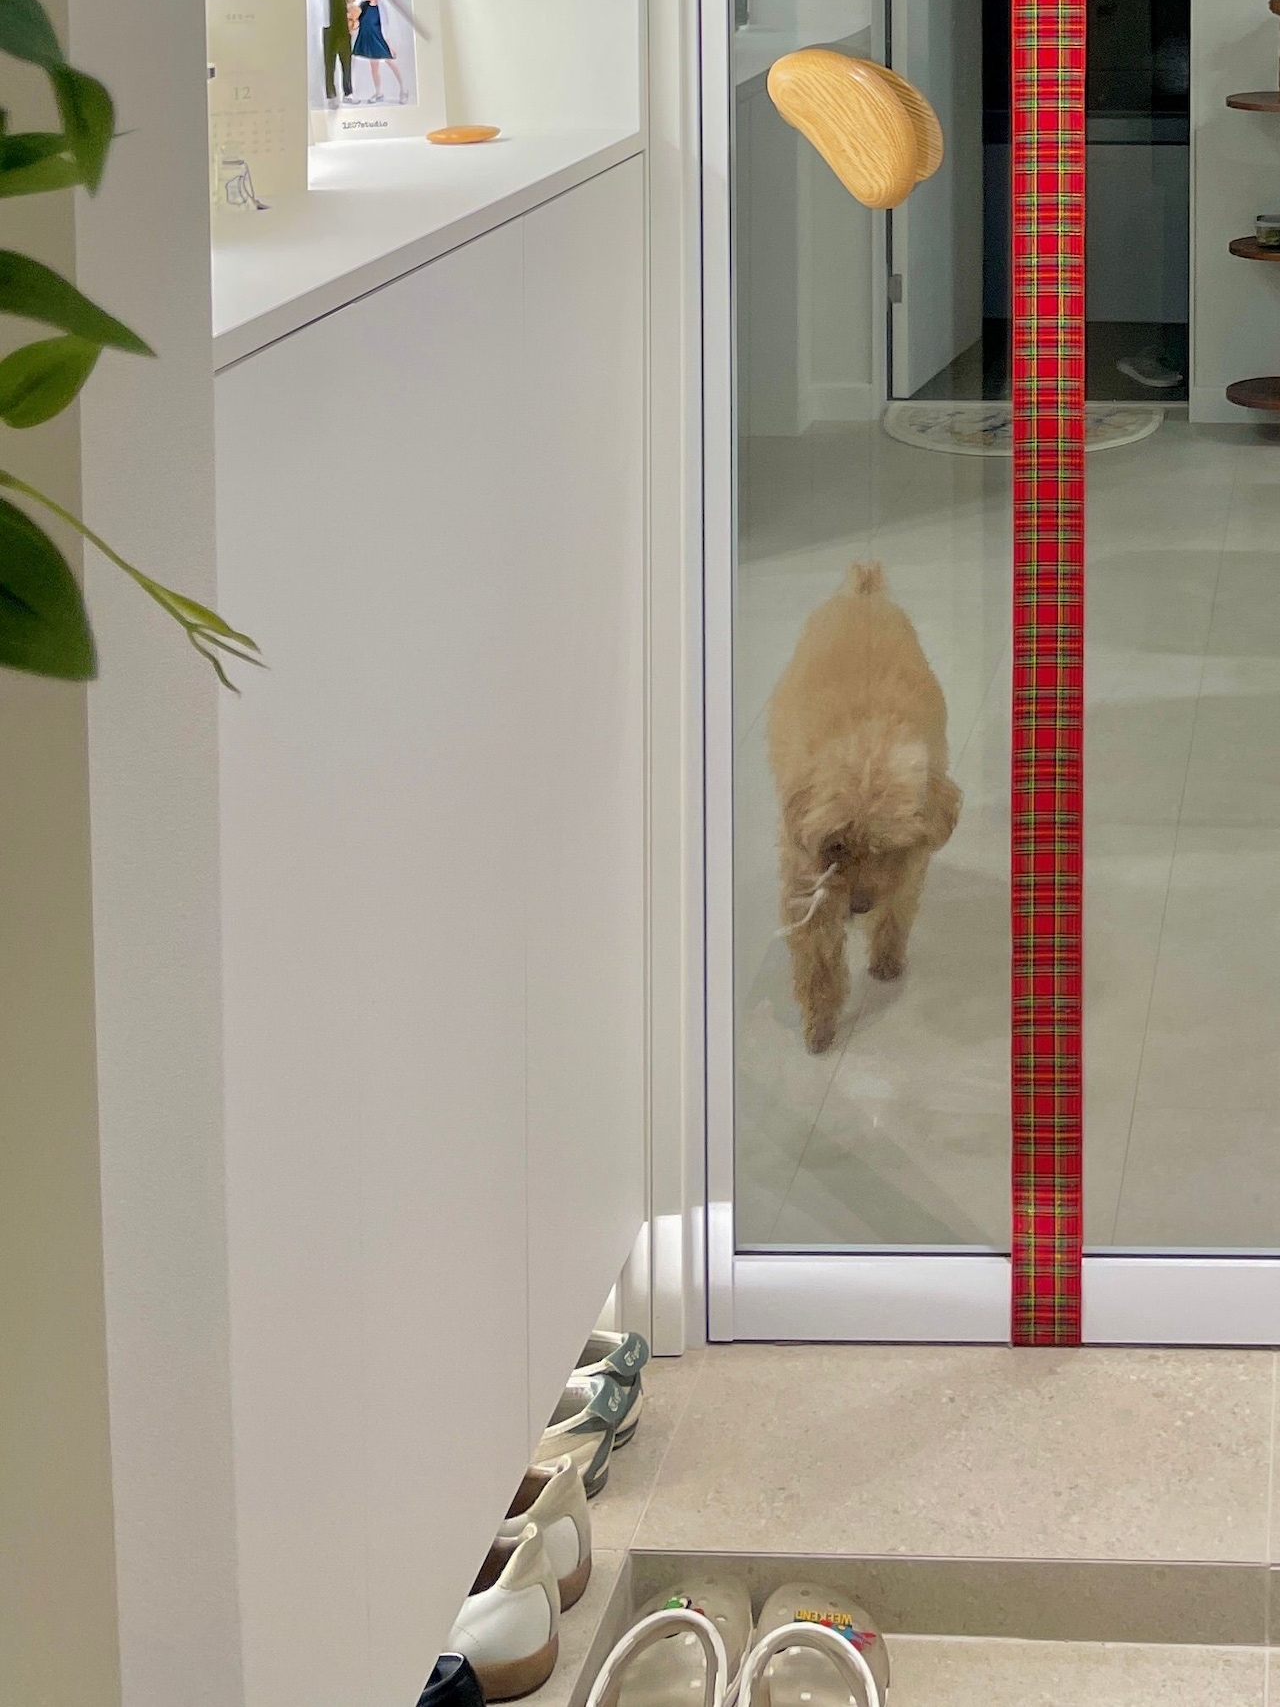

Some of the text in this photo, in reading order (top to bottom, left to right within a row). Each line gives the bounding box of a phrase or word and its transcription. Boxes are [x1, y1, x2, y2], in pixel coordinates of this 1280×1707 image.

[232, 85, 252, 101] 12
[624, 1339, 642, 1367] Tiger
[796, 1609, 852, 1626] WEEKEND
